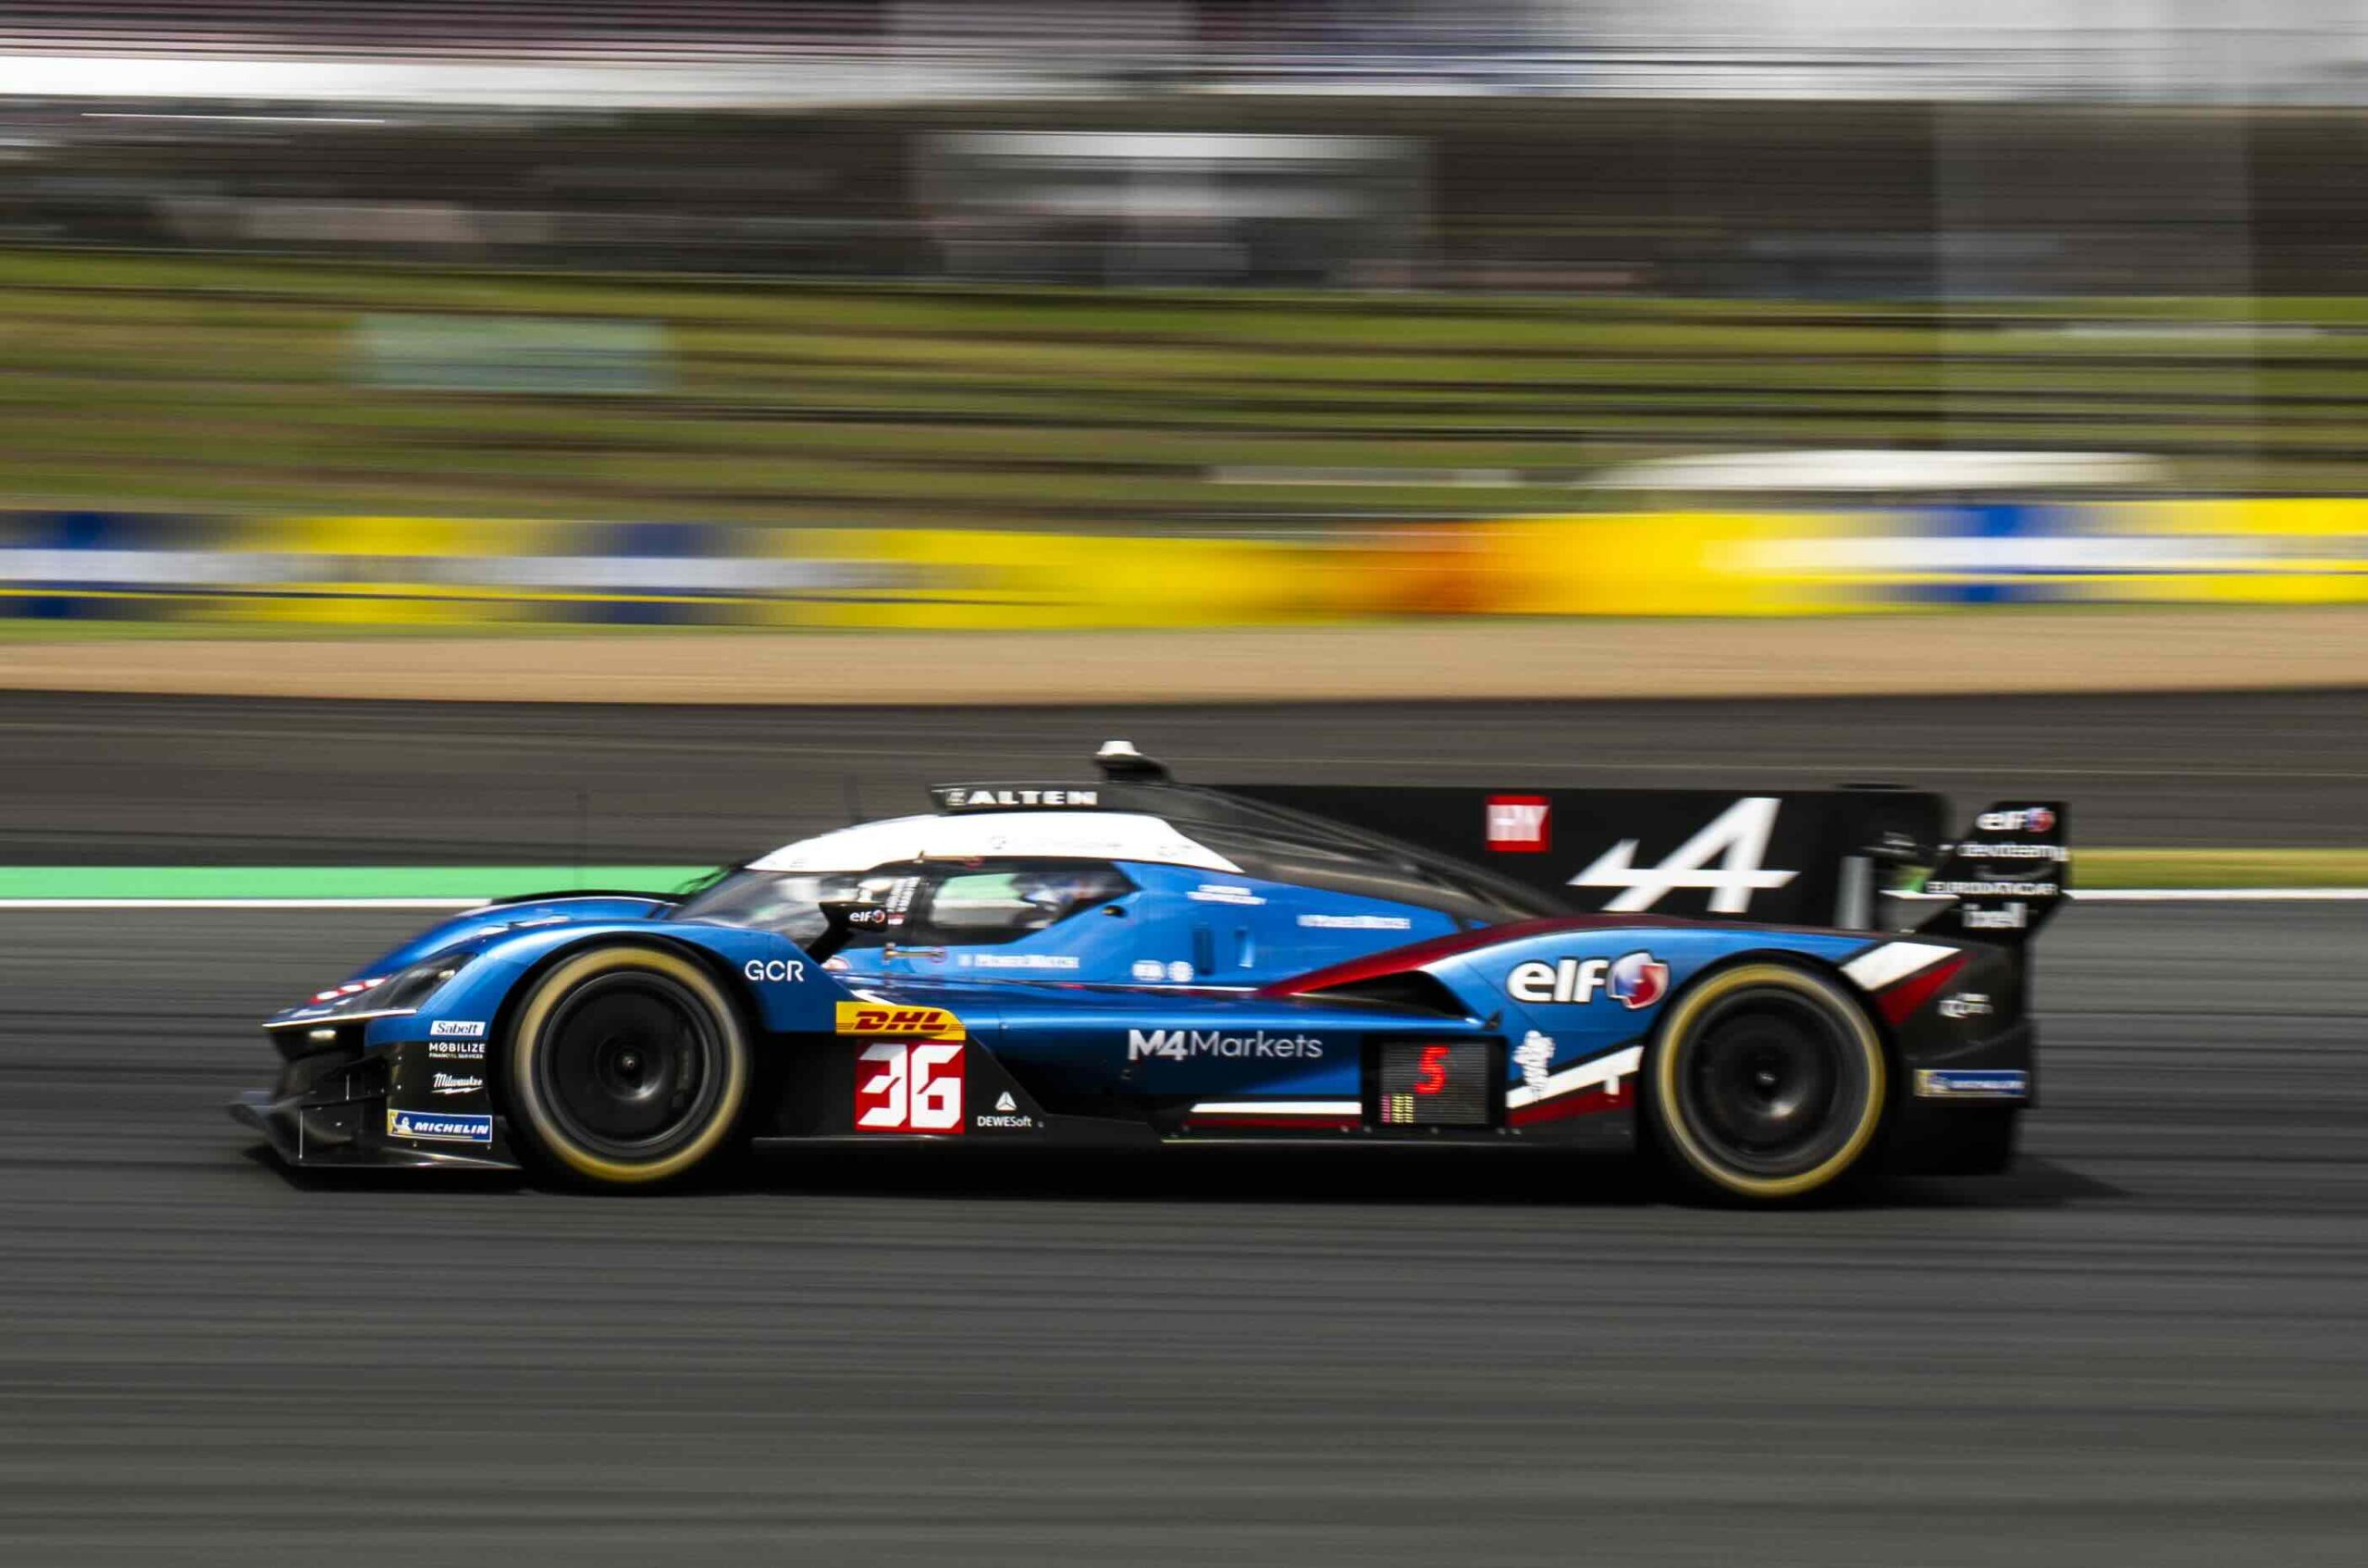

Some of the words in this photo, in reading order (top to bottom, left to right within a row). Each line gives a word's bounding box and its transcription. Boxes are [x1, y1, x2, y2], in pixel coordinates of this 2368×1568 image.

[968, 790, 1098, 806] ALTEN
[849, 911, 871, 922] elf
[745, 959, 804, 982] GCR
[1507, 958, 1611, 1003] elf
[852, 1011, 948, 1031] DHL
[1414, 1044, 1450, 1094] 5
[857, 1043, 965, 1129] 36
[413, 1121, 489, 1135] MICHELIN
[977, 1116, 1032, 1128] DEWESoft
